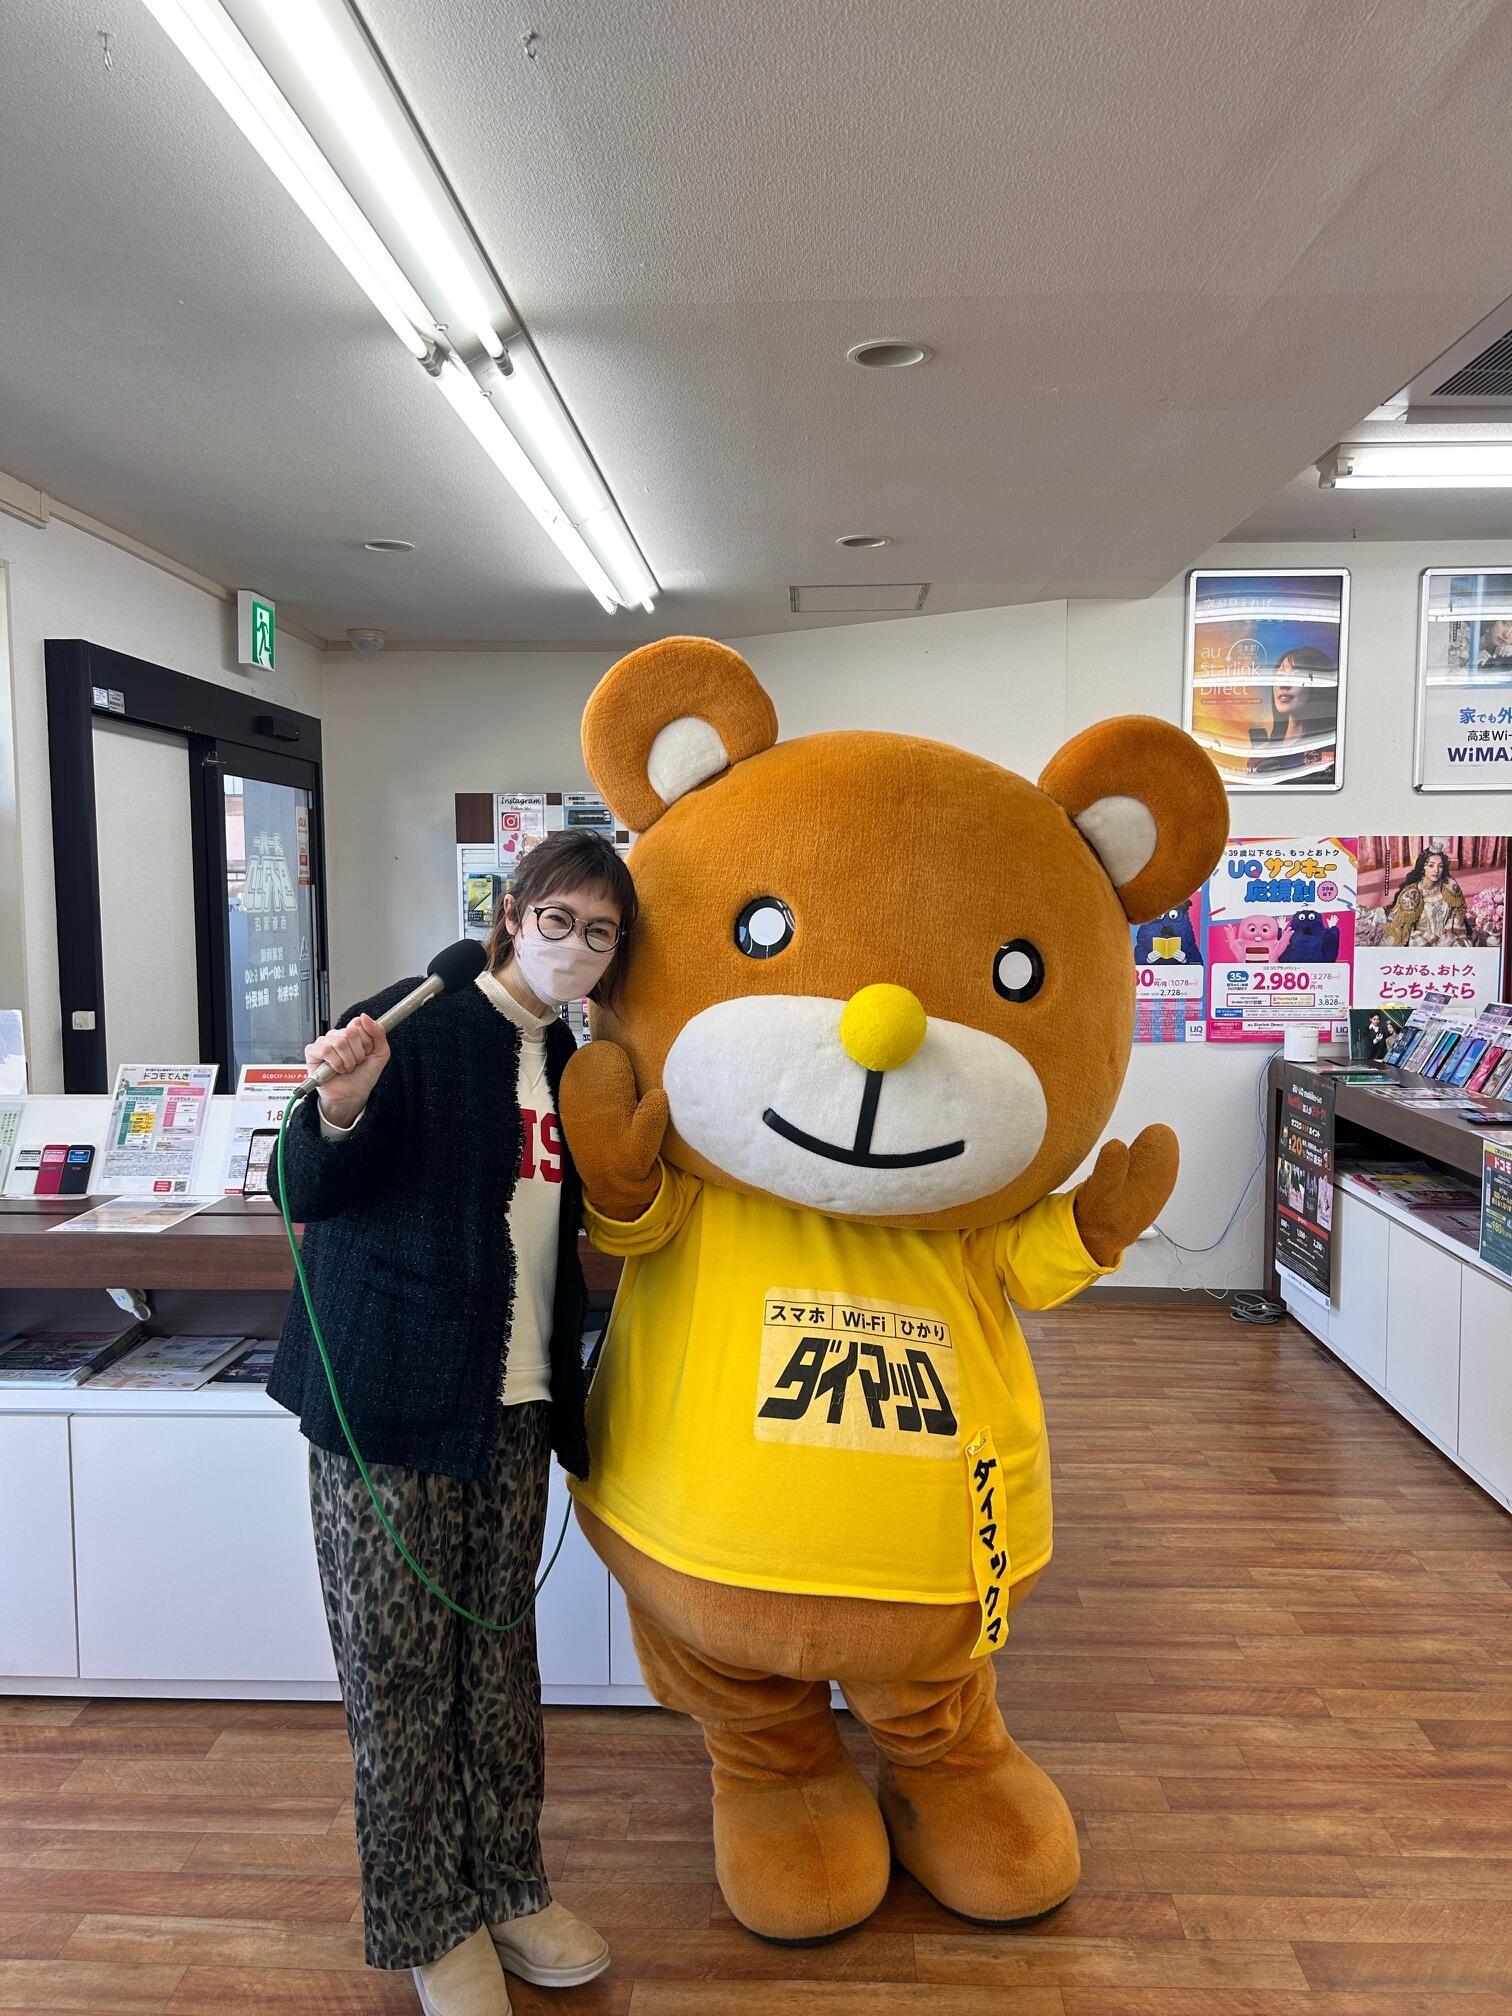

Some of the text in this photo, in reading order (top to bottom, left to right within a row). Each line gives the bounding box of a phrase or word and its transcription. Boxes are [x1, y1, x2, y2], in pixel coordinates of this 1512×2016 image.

[1201, 647, 1220, 659] au
[1200, 661, 1261, 677] Starlink
[501, 797, 542, 805] Instagram
[1229, 849, 1340, 857] 39歳以下なら、もっとおトク
[1228, 858, 1337, 878] UQ サンキュー
[1380, 964, 1476, 976] つながる、おトク、
[1253, 972, 1310, 991] 2,980
[1190, 1025, 1203, 1033] UQ
[770, 1304, 945, 1342] スマホ Wi-Fi ひかり
[757, 1337, 959, 1437] ダイマック
[972, 1457, 1008, 1645] ダイマックマ
